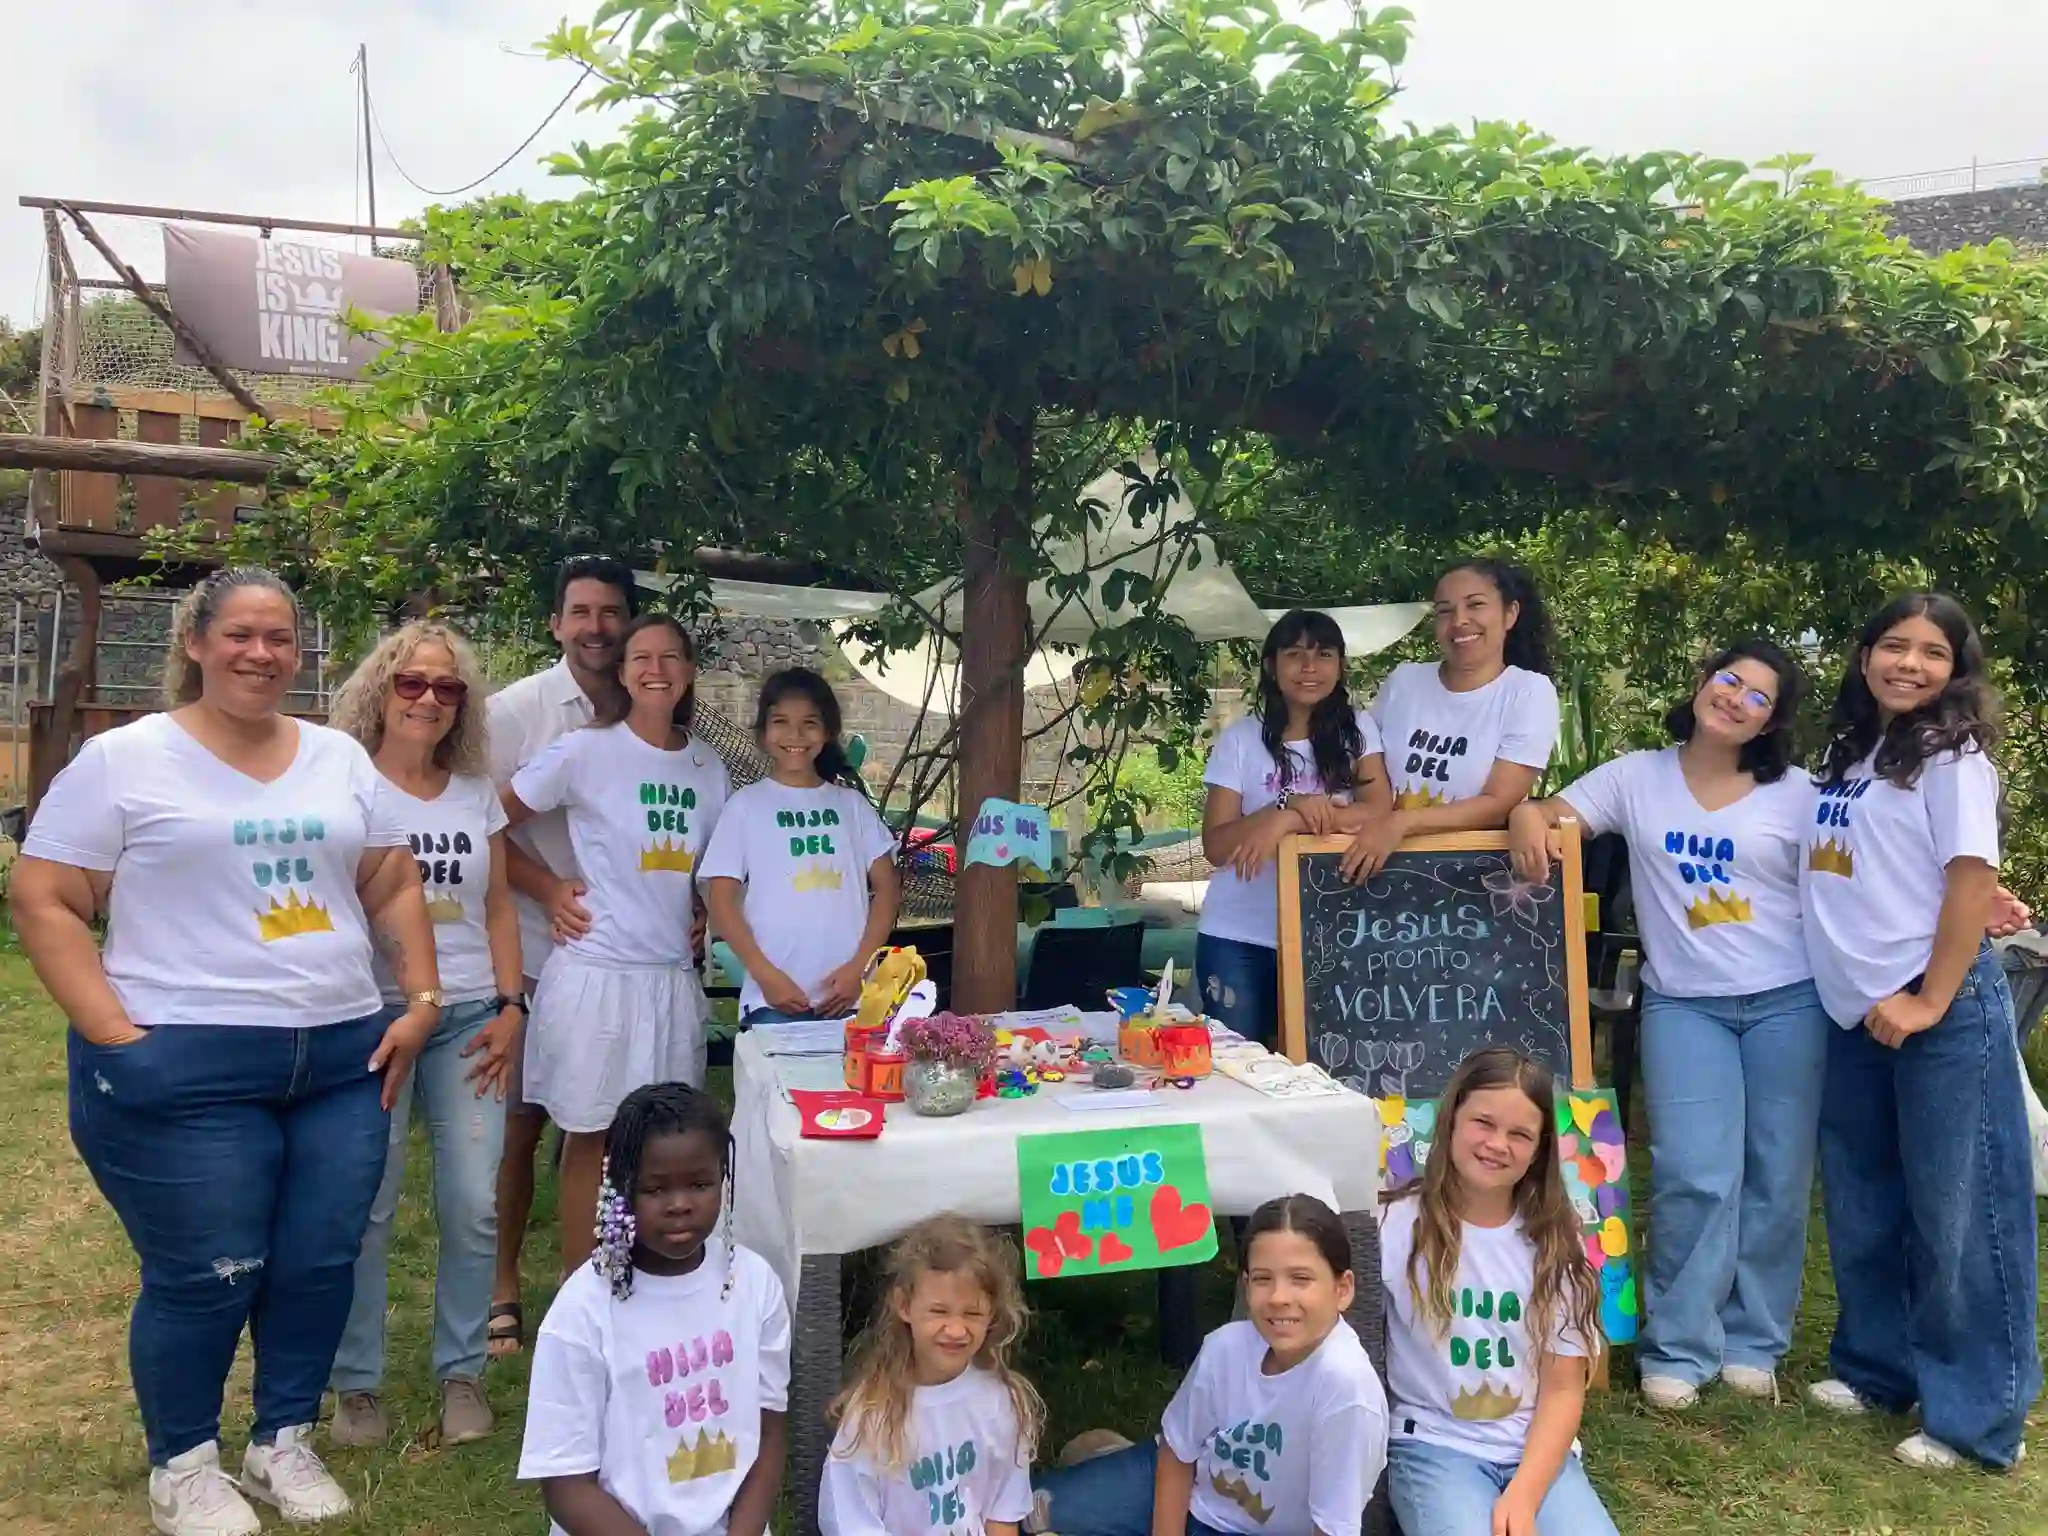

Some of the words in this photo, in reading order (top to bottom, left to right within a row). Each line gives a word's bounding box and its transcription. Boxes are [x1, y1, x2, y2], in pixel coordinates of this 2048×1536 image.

[256, 238, 343, 281] JESUS
[256, 270, 288, 312] IS
[1408, 729, 1468, 757] HIJA
[1405, 756, 1450, 781] DEL
[640, 783, 696, 810] HIJA
[233, 814, 325, 846] HIJA
[647, 810, 688, 834] DEL
[776, 808, 840, 828] HIJA
[973, 815, 1004, 836] US
[1817, 802, 1849, 827] DEL
[790, 834, 836, 857] DEL
[1665, 831, 1735, 862] HIJA
[252, 857, 314, 887] DEL
[416, 859, 463, 885] DEL
[1678, 862, 1730, 884] DEL
[1367, 941, 1471, 980] pronto
[1334, 970, 1506, 1023] VOLVERÁ
[1050, 1151, 1164, 1195] JESUS
[646, 1329, 734, 1386] HIJA
[1450, 1336, 1516, 1370] DEL
[664, 1378, 729, 1428] DEL
[1224, 1419, 1283, 1457] IJA
[909, 1440, 976, 1491] HIJA
[1214, 1434, 1271, 1482] DEL
[929, 1484, 966, 1526] DEL
